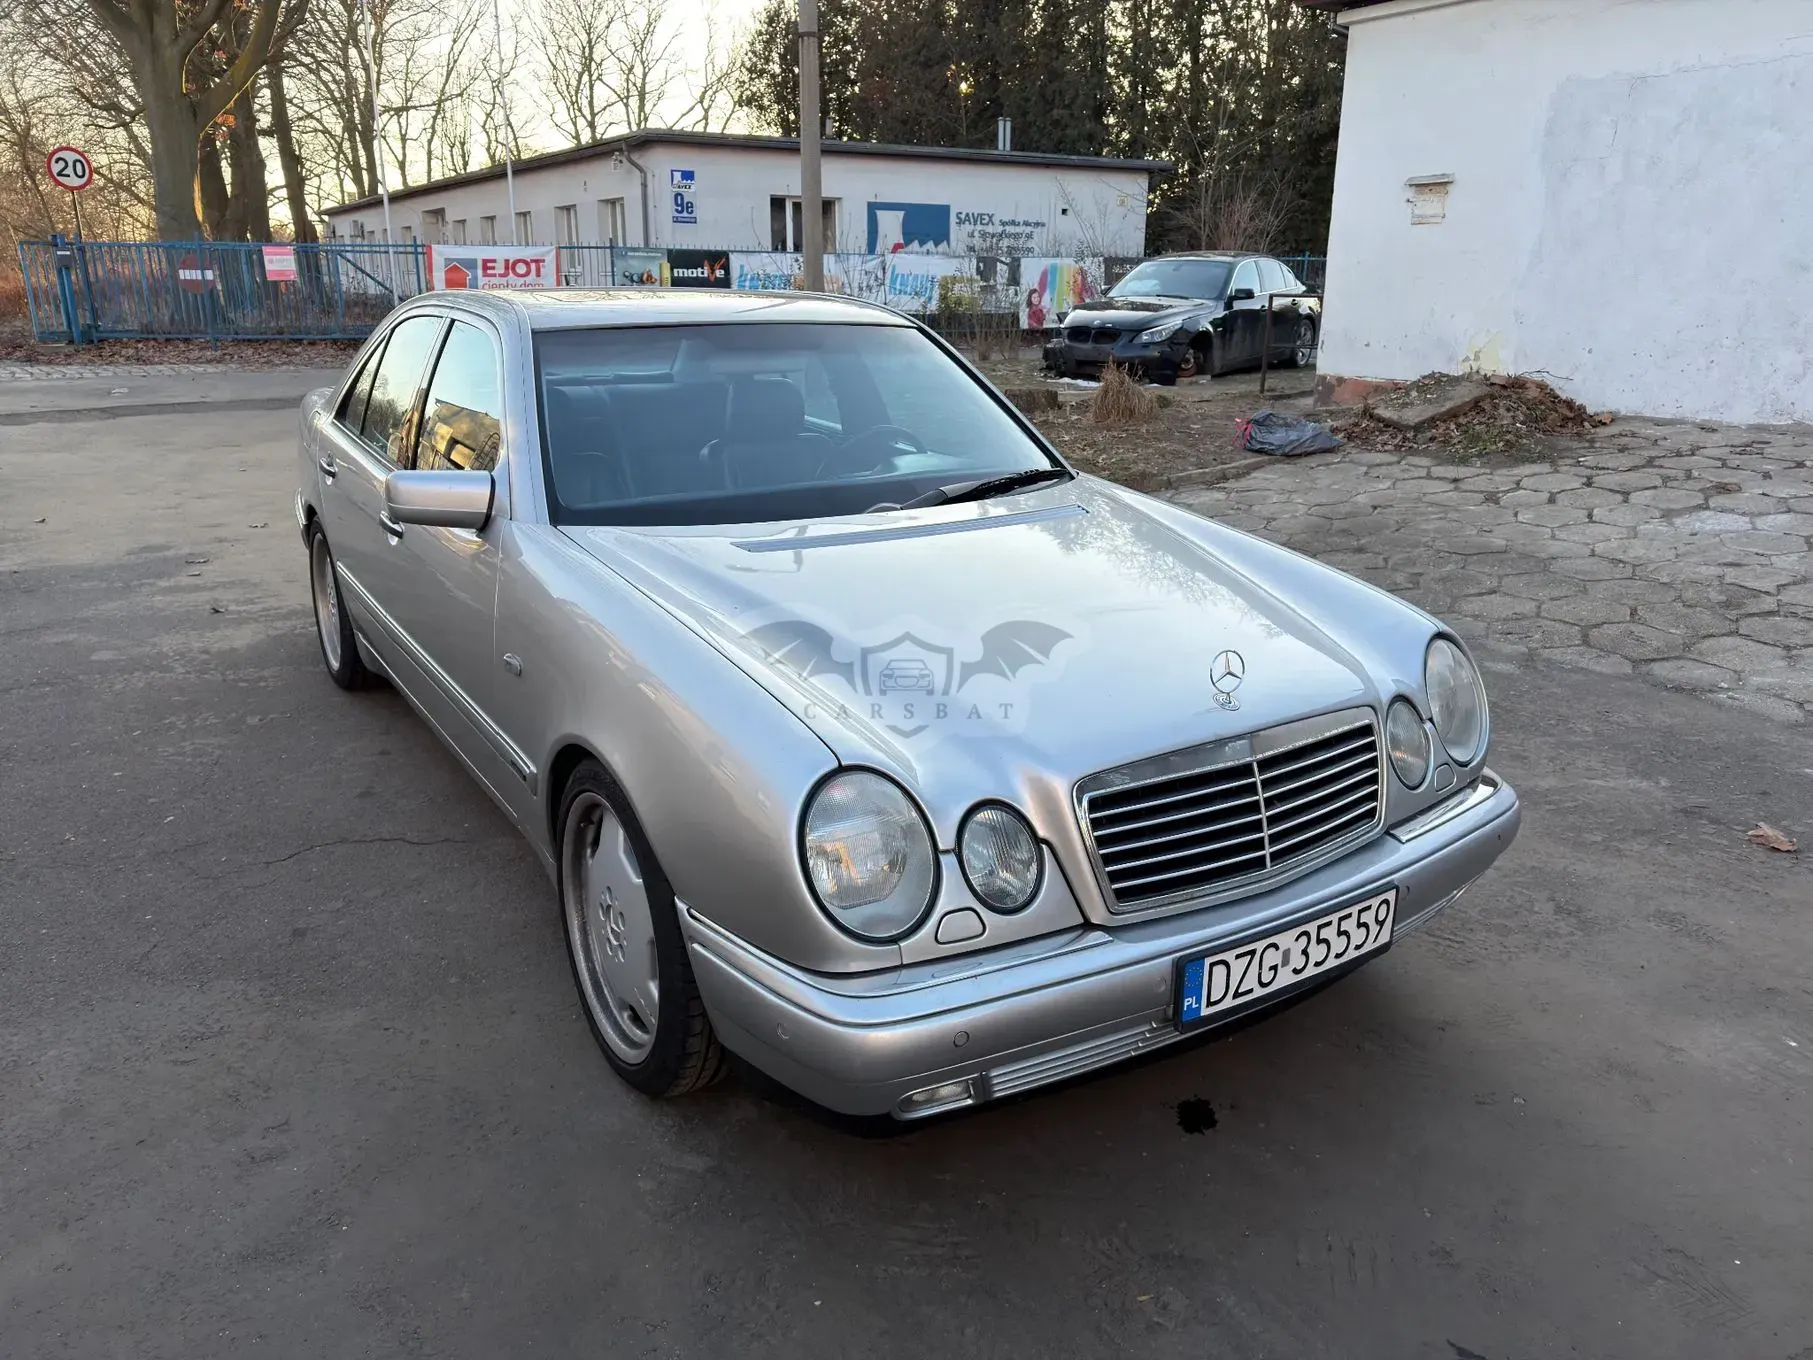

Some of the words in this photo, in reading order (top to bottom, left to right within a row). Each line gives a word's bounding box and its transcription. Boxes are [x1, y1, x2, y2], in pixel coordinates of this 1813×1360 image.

[54, 156, 86, 179] 20
[674, 192, 694, 215] 9e
[955, 211, 995, 226] SAVEX
[481, 258, 545, 278] EJOT
[1206, 942, 1281, 1009] DZG
[1291, 898, 1391, 976] 35559
[1183, 996, 1199, 1011] PL
